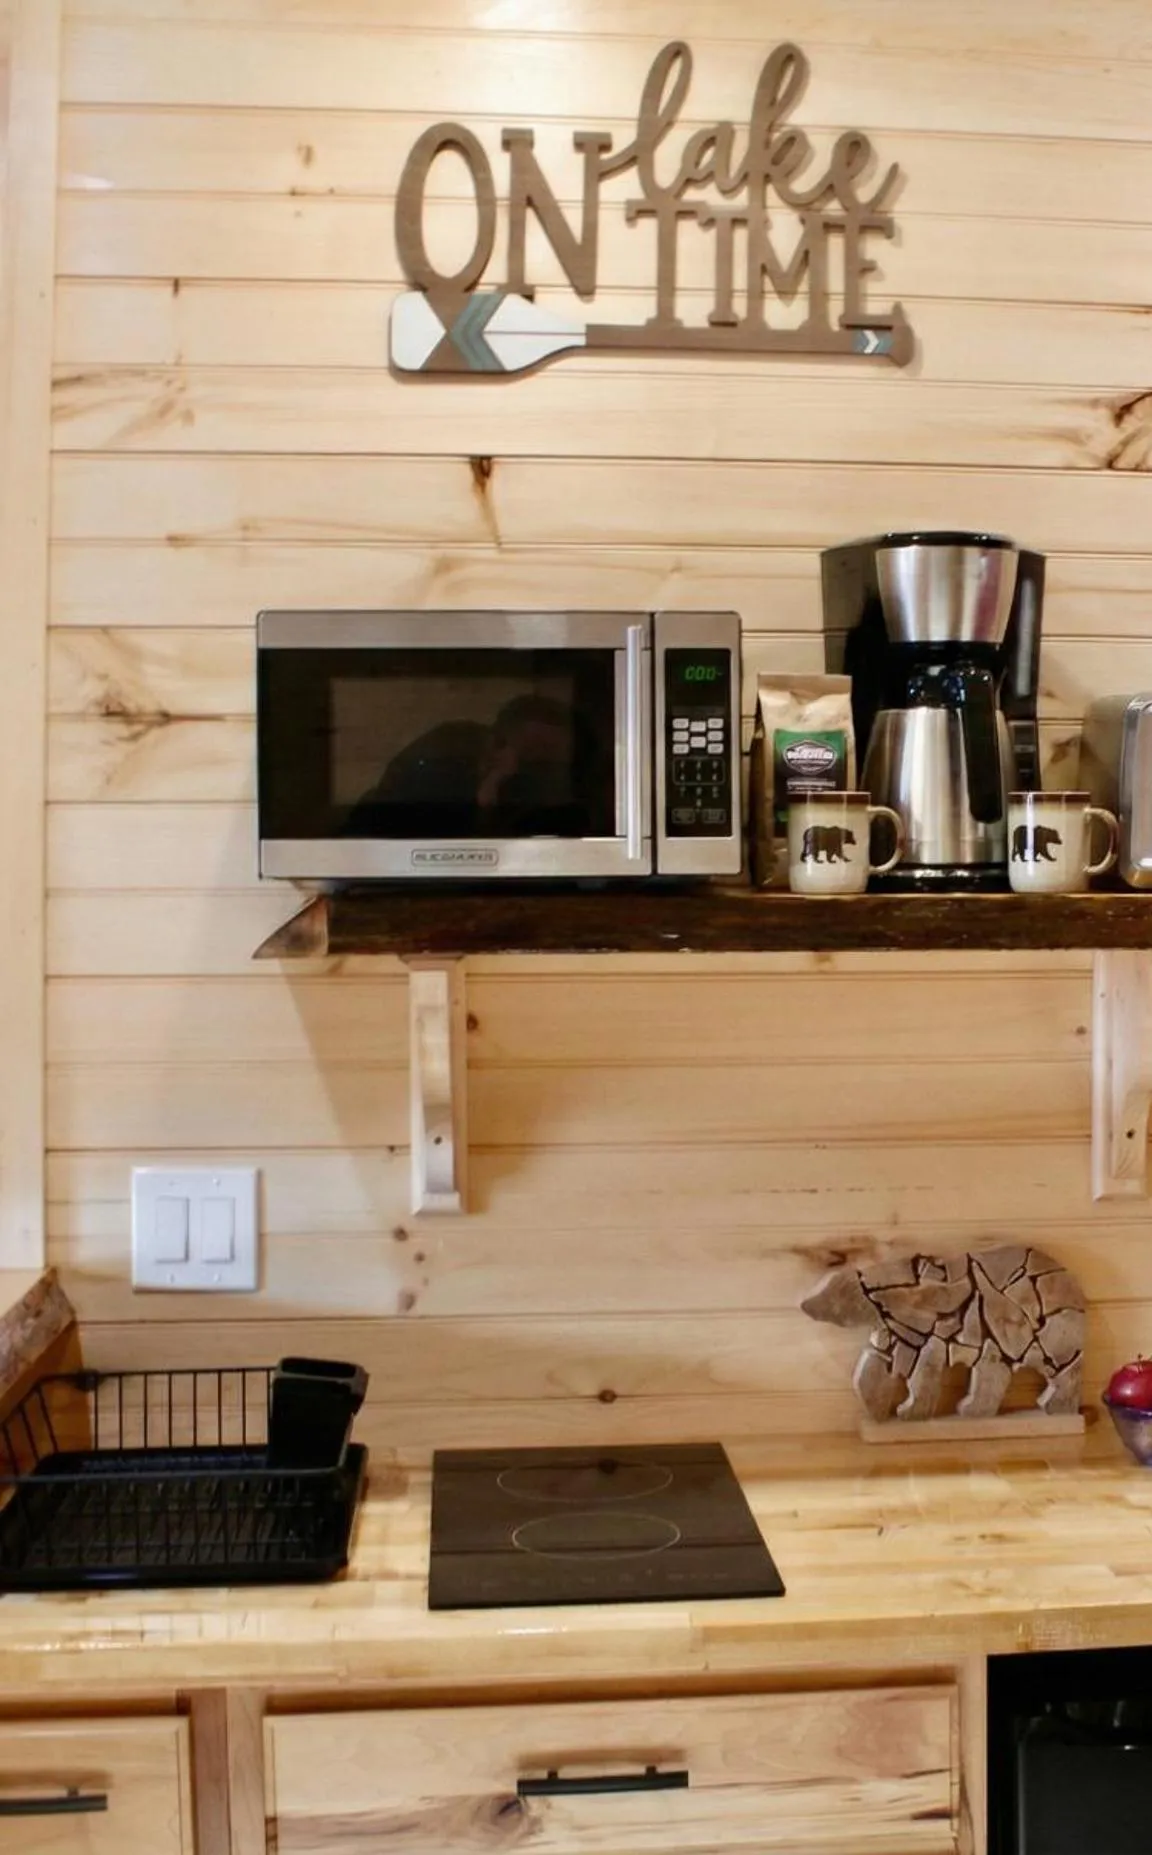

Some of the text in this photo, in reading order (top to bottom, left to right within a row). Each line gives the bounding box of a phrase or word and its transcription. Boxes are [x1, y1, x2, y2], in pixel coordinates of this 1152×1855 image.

[395, 122, 612, 301] ON
[600, 40, 899, 213] lake
[625, 199, 896, 331] TIME
